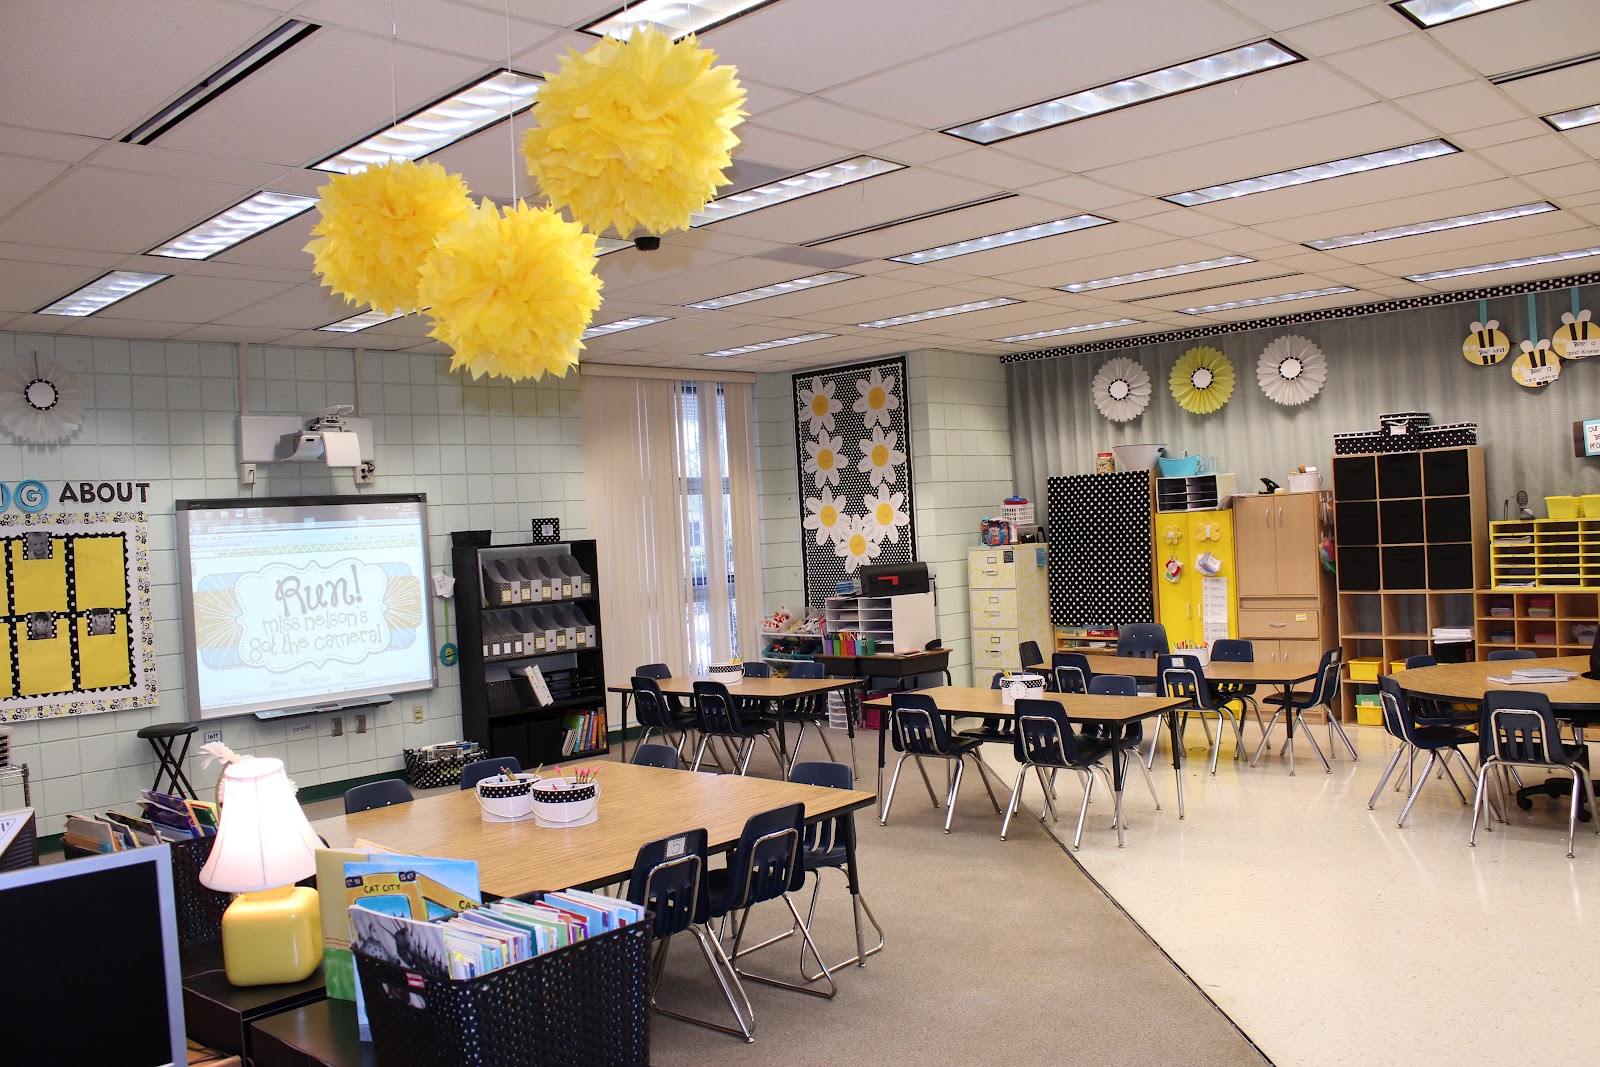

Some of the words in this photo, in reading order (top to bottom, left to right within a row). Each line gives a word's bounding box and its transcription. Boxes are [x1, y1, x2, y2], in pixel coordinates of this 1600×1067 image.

[59, 482, 150, 503] ABOUT
[275, 564, 363, 617] Run!
[262, 614, 300, 635] miss
[304, 604, 369, 631] nelson's
[249, 635, 278, 661] got
[282, 632, 310, 654] the
[314, 624, 383, 650] camera!
[671, 840, 681, 855] 5
[364, 884, 379, 894] CAT
[382, 883, 401, 892] CITY
